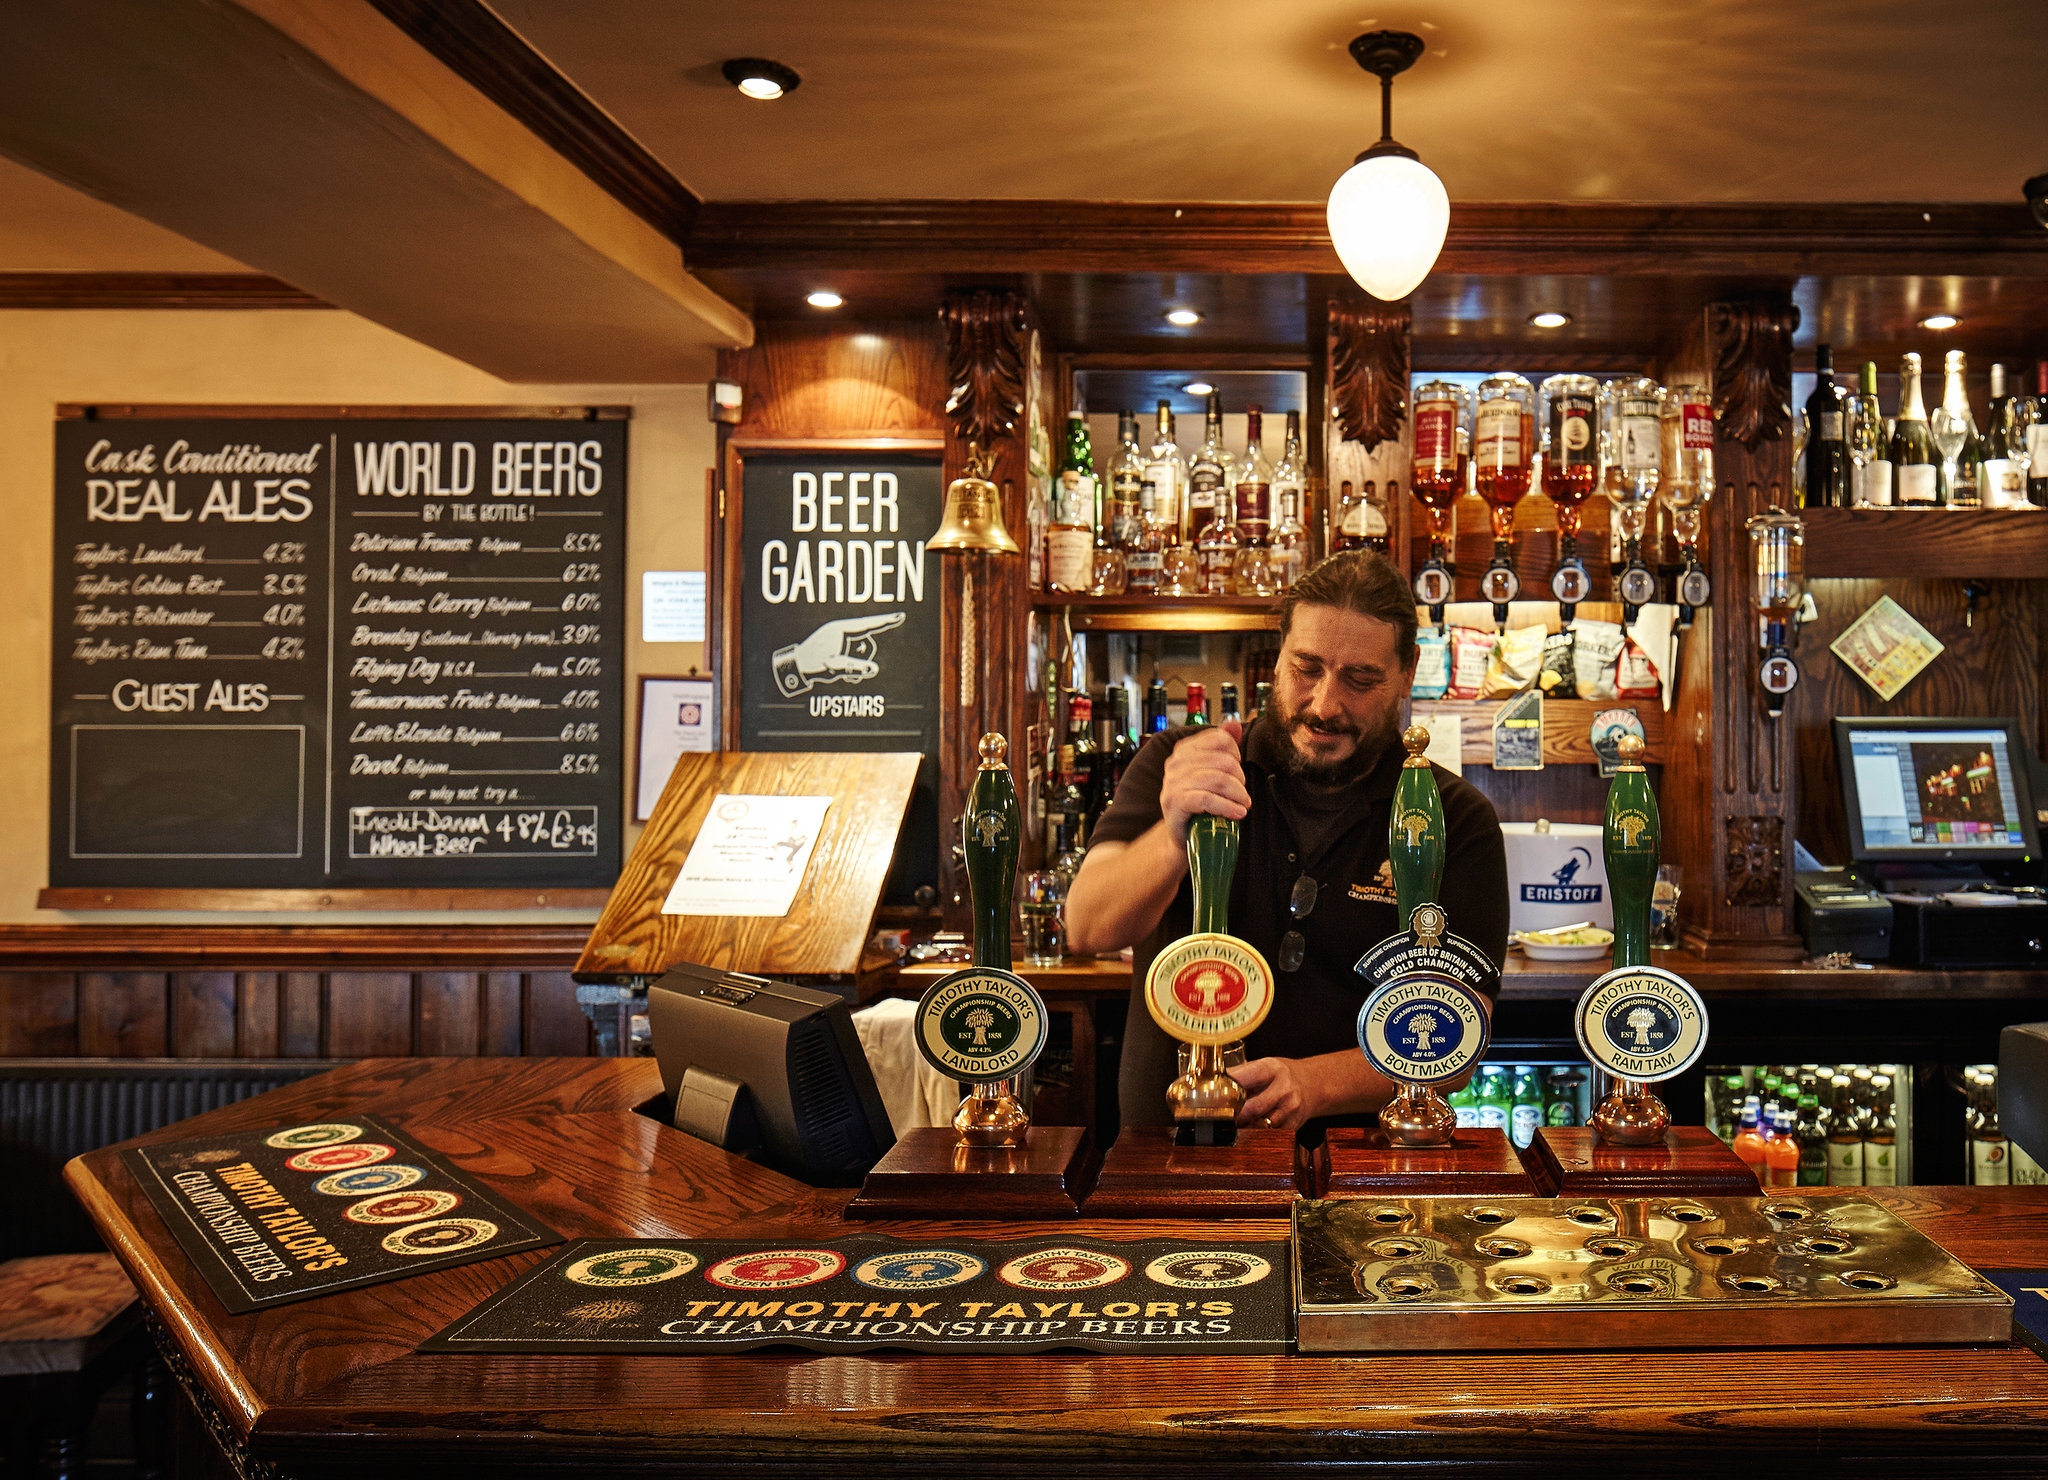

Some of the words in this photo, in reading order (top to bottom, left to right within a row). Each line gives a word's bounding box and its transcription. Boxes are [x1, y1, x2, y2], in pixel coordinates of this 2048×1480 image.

[84, 439, 157, 474] Cask
[163, 439, 323, 475] Conditioned
[353, 440, 476, 498] WORLD
[491, 440, 603, 498] BEERS
[85, 479, 192, 523] REAL
[198, 479, 314, 523] ALES
[423, 503, 444, 522] BY
[450, 503, 477, 522] THE
[792, 471, 899, 533] BEER
[351, 562, 400, 583] Orval
[761, 539, 925, 604] GARDEN
[350, 657, 408, 684] Flying
[407, 656, 441, 685] Dog
[111, 678, 202, 713] GUEST
[204, 678, 269, 713] ALES
[809, 695, 885, 718] UPSTAIRS
[408, 788, 427, 801] or
[429, 784, 456, 805] why
[456, 785, 479, 801] not
[484, 784, 508, 805] try
[434, 833, 488, 855] Beer
[1526, 886, 1598, 901] ERISTOFF
[1362, 946, 1384, 969] SUPREME
[1382, 936, 1410, 952] CHAMPION
[1446, 937, 1471, 954] SUPREME
[1469, 949, 1493, 973] CHAMPION
[1373, 949, 1408, 979] CHAMPION
[1408, 947, 1428, 959] BEER
[1429, 947, 1439, 957] OF
[1439, 949, 1468, 970] BRITAIN
[1466, 964, 1482, 983] 2014
[1390, 960, 1415, 978] GOLD
[1416, 957, 1466, 981] CHAMPION
[928, 980, 982, 1017] TIMOTHY
[984, 980, 1034, 1020] TAYLOR'S
[949, 999, 996, 1019] CHAMPIONSHIP
[996, 1003, 1013, 1020] BEERS
[1371, 985, 1423, 1024] TIMOTHY
[1426, 985, 1477, 1023] TAYLOR'S
[1591, 980, 1643, 1016] TIMOTHY
[1645, 980, 1695, 1020] TAYLOR'S
[1611, 998, 1657, 1018] CHAMPIONSHIP
[1657, 1003, 1674, 1020] BEERS
[1392, 1004, 1438, 1025] CHAMPIONSHIP
[1438, 1006, 1455, 1024] BEERS
[941, 1049, 1019, 1072] LANDLORD
[1384, 1050, 1468, 1076] BOLTMAKER
[1611, 1052, 1643, 1071] RAM
[1645, 1052, 1676, 1071] TAM
[172, 1170, 262, 1245] CHAMPIONSHIP
[231, 1242, 293, 1282] BEERS
[215, 1161, 290, 1210] TIMOTHY
[258, 1207, 348, 1272] TAYLOR'S
[719, 1275, 772, 1288] GOLDEN
[868, 1277, 959, 1288] BOLTMAKER
[1018, 1279, 1059, 1289] DARK
[1062, 1279, 1102, 1289] MILD
[1172, 1279, 1207, 1288] RAM
[685, 1300, 940, 1319] TIMOTHY
[960, 1300, 1235, 1319] TAYLOR'S
[660, 1319, 1067, 1337] CHAMPIONSHIP
[1080, 1319, 1232, 1336] BEERS
